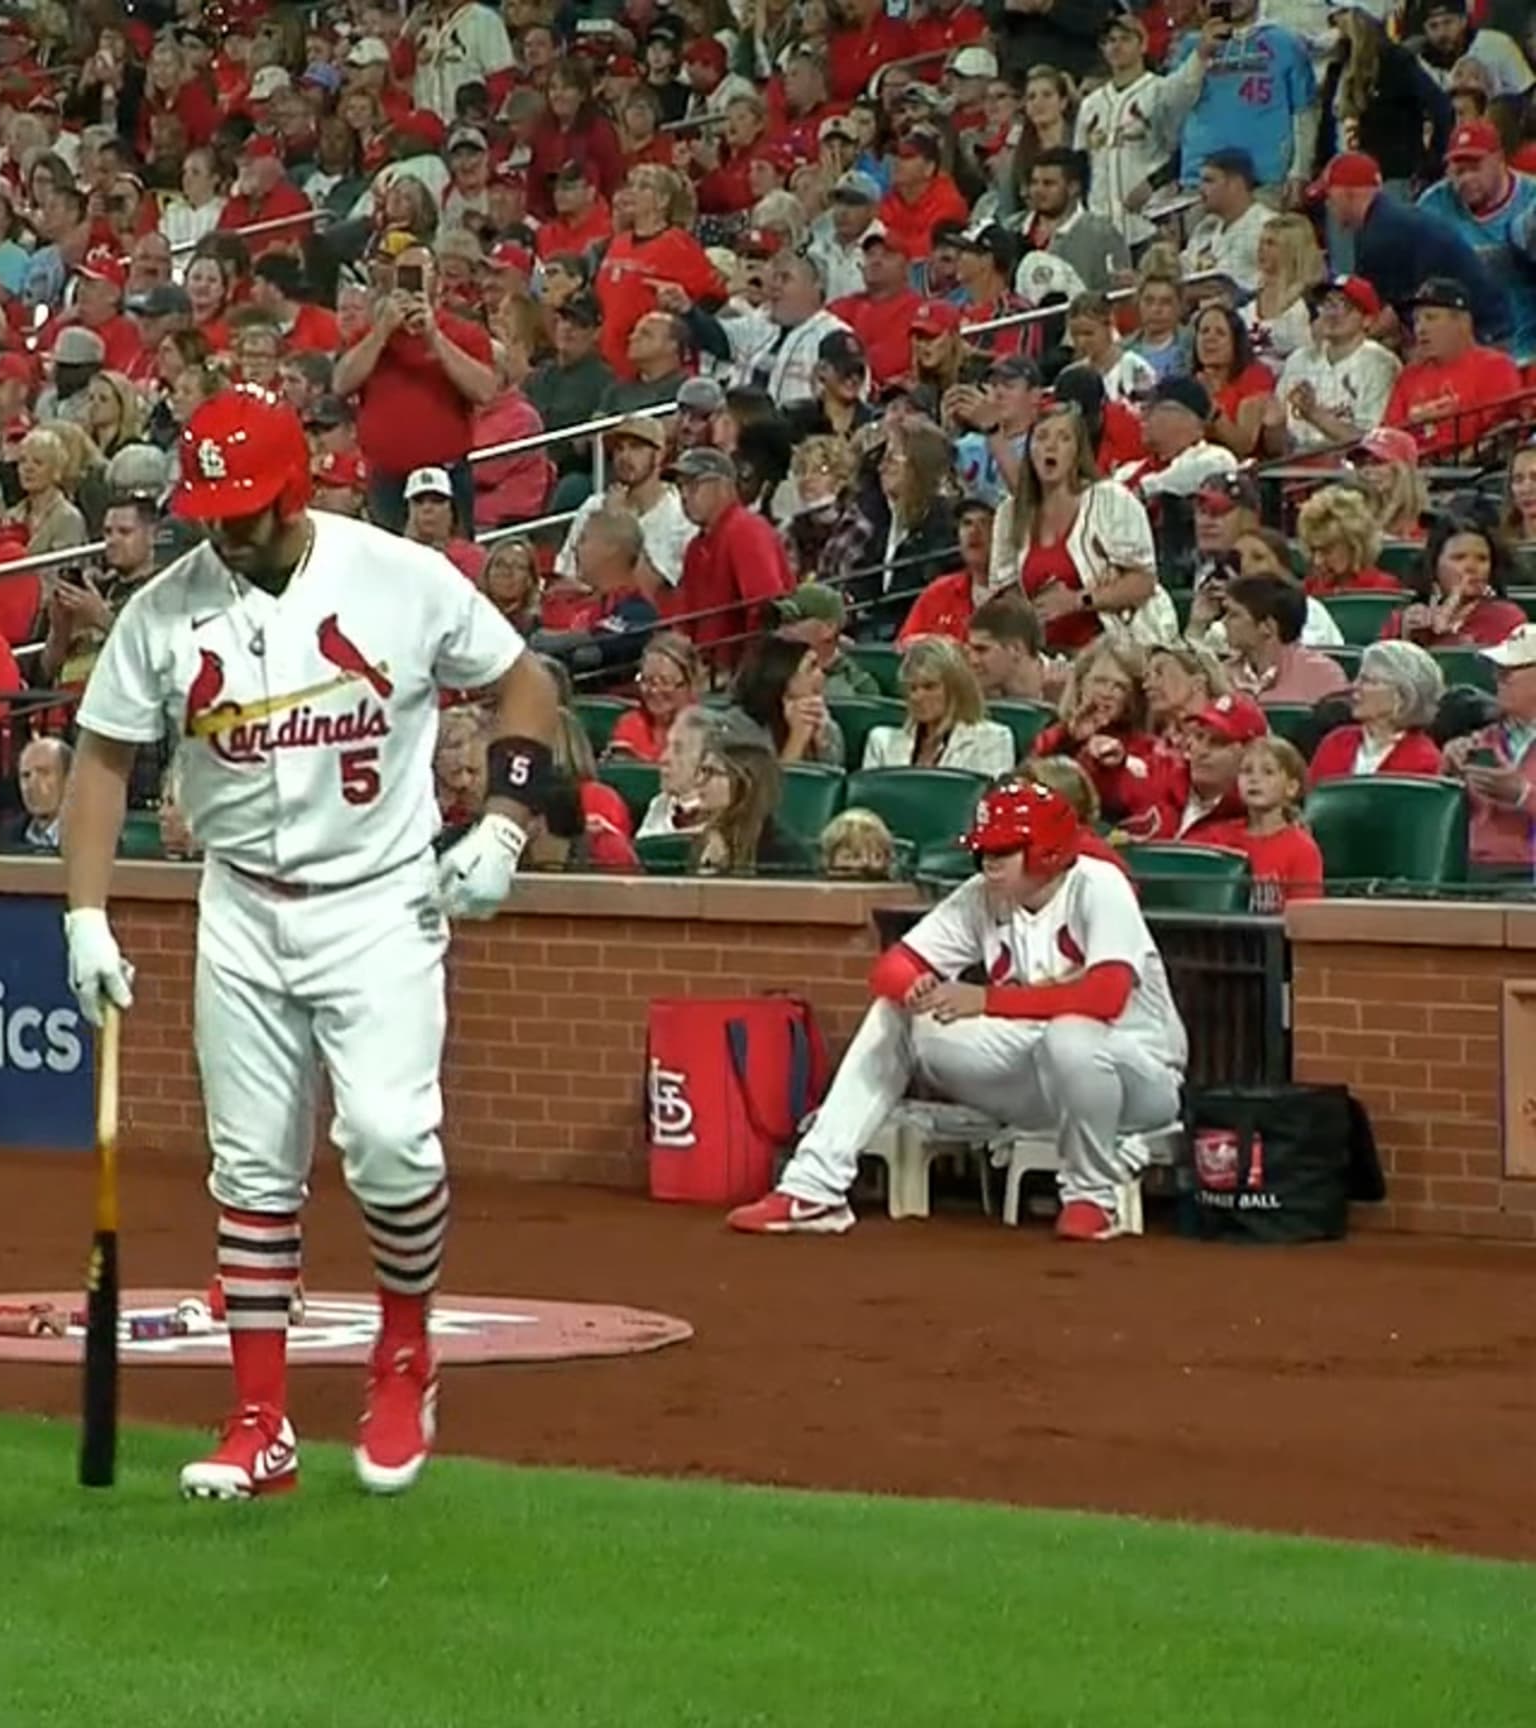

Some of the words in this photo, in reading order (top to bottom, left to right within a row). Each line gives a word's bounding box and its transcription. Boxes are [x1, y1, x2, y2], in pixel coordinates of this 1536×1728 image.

[1239, 76, 1273, 104] 45
[209, 700, 391, 763] Cardinals
[339, 747, 382, 806] 5
[509, 756, 532, 785] 5
